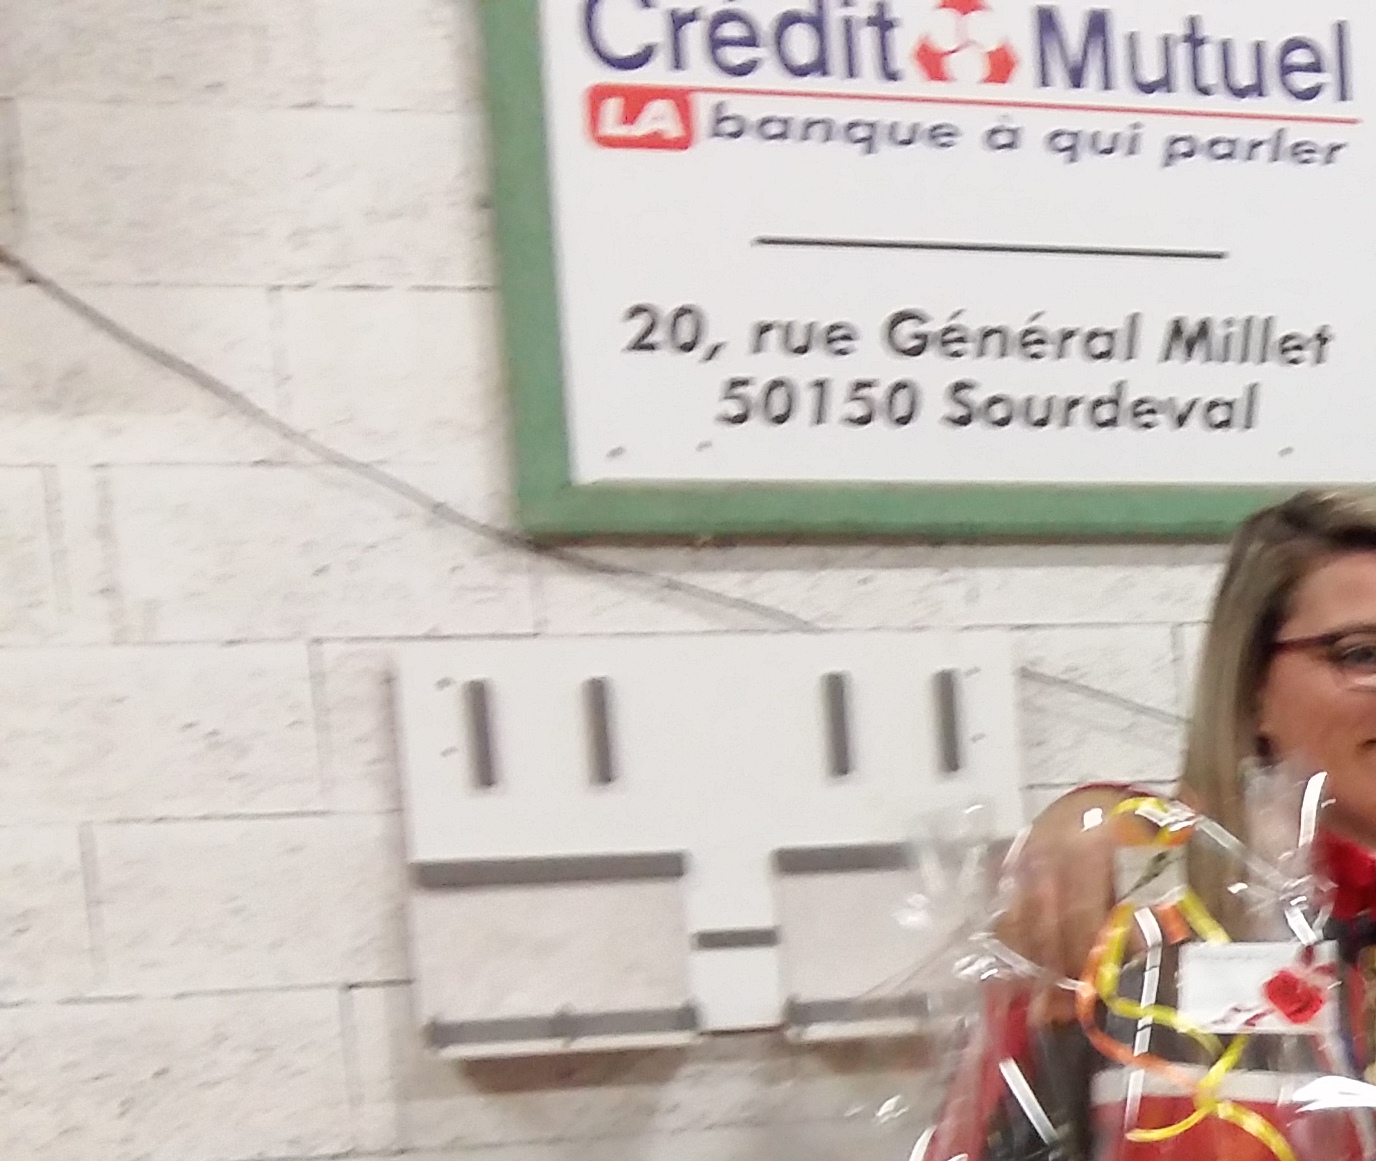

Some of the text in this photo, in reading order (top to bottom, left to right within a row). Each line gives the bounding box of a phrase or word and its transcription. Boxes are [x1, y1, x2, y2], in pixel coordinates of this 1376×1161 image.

[584, 0, 1352, 102] Crédit Mutuel
[601, 96, 1348, 168] LA banque à qui parler
[622, 303, 1337, 368] 20, rue Général Millet
[713, 376, 1260, 433] 50150 Sourdeval
